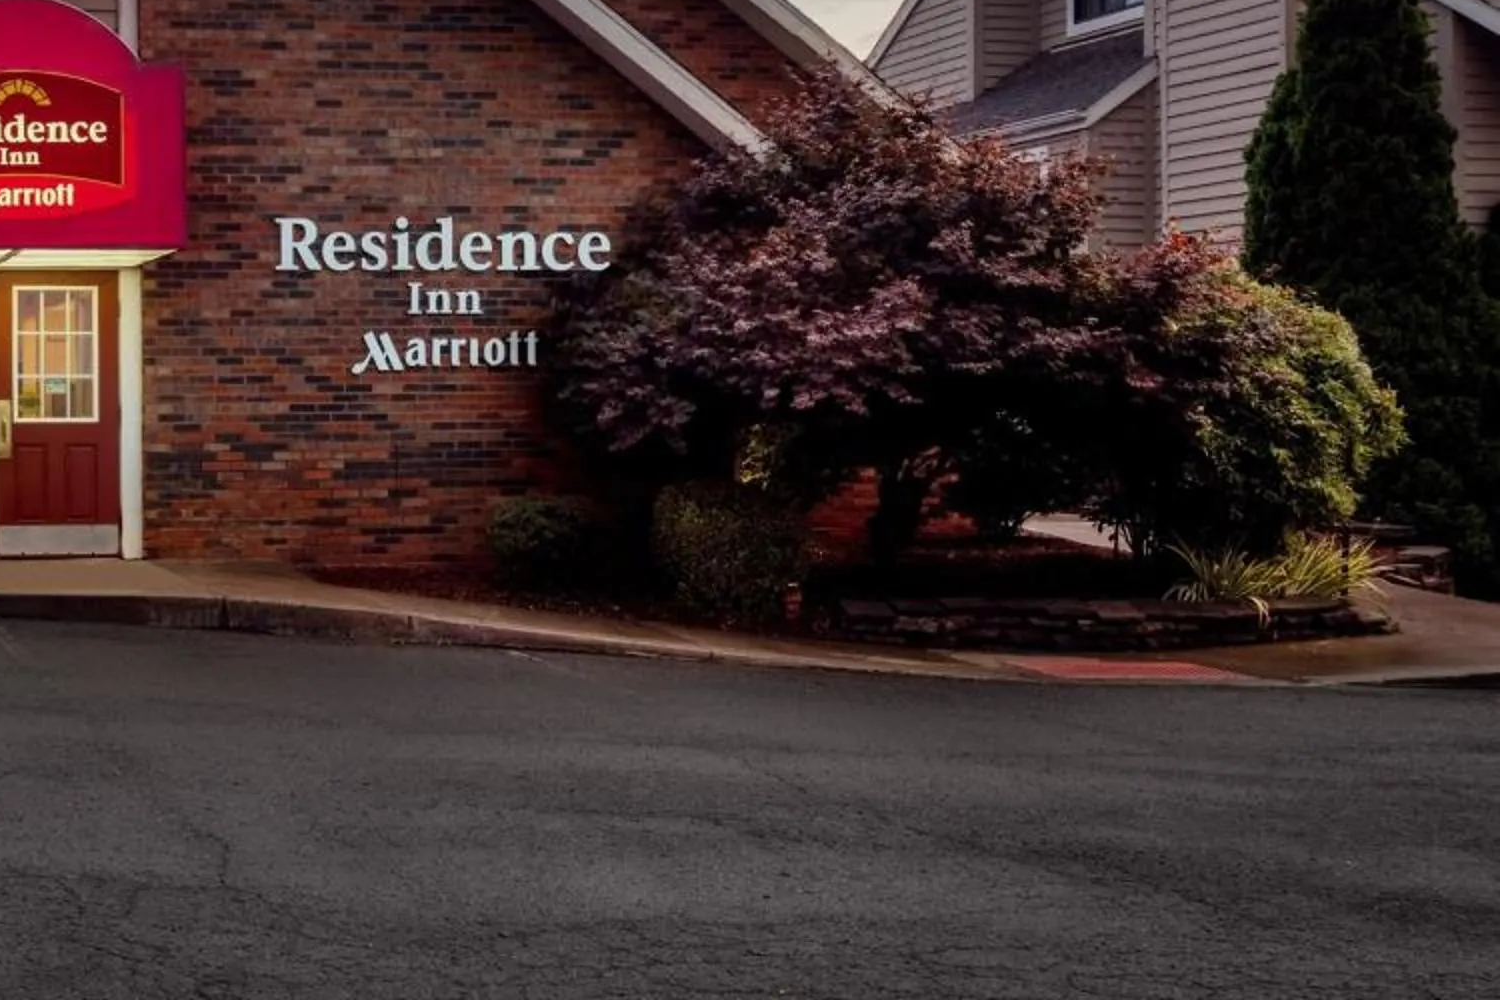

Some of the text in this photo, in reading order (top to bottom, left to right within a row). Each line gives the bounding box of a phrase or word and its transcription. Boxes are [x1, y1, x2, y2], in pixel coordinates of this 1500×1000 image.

[274, 216, 612, 273] Residence
[406, 281, 485, 316] Inn
[351, 330, 539, 375] Marriott
